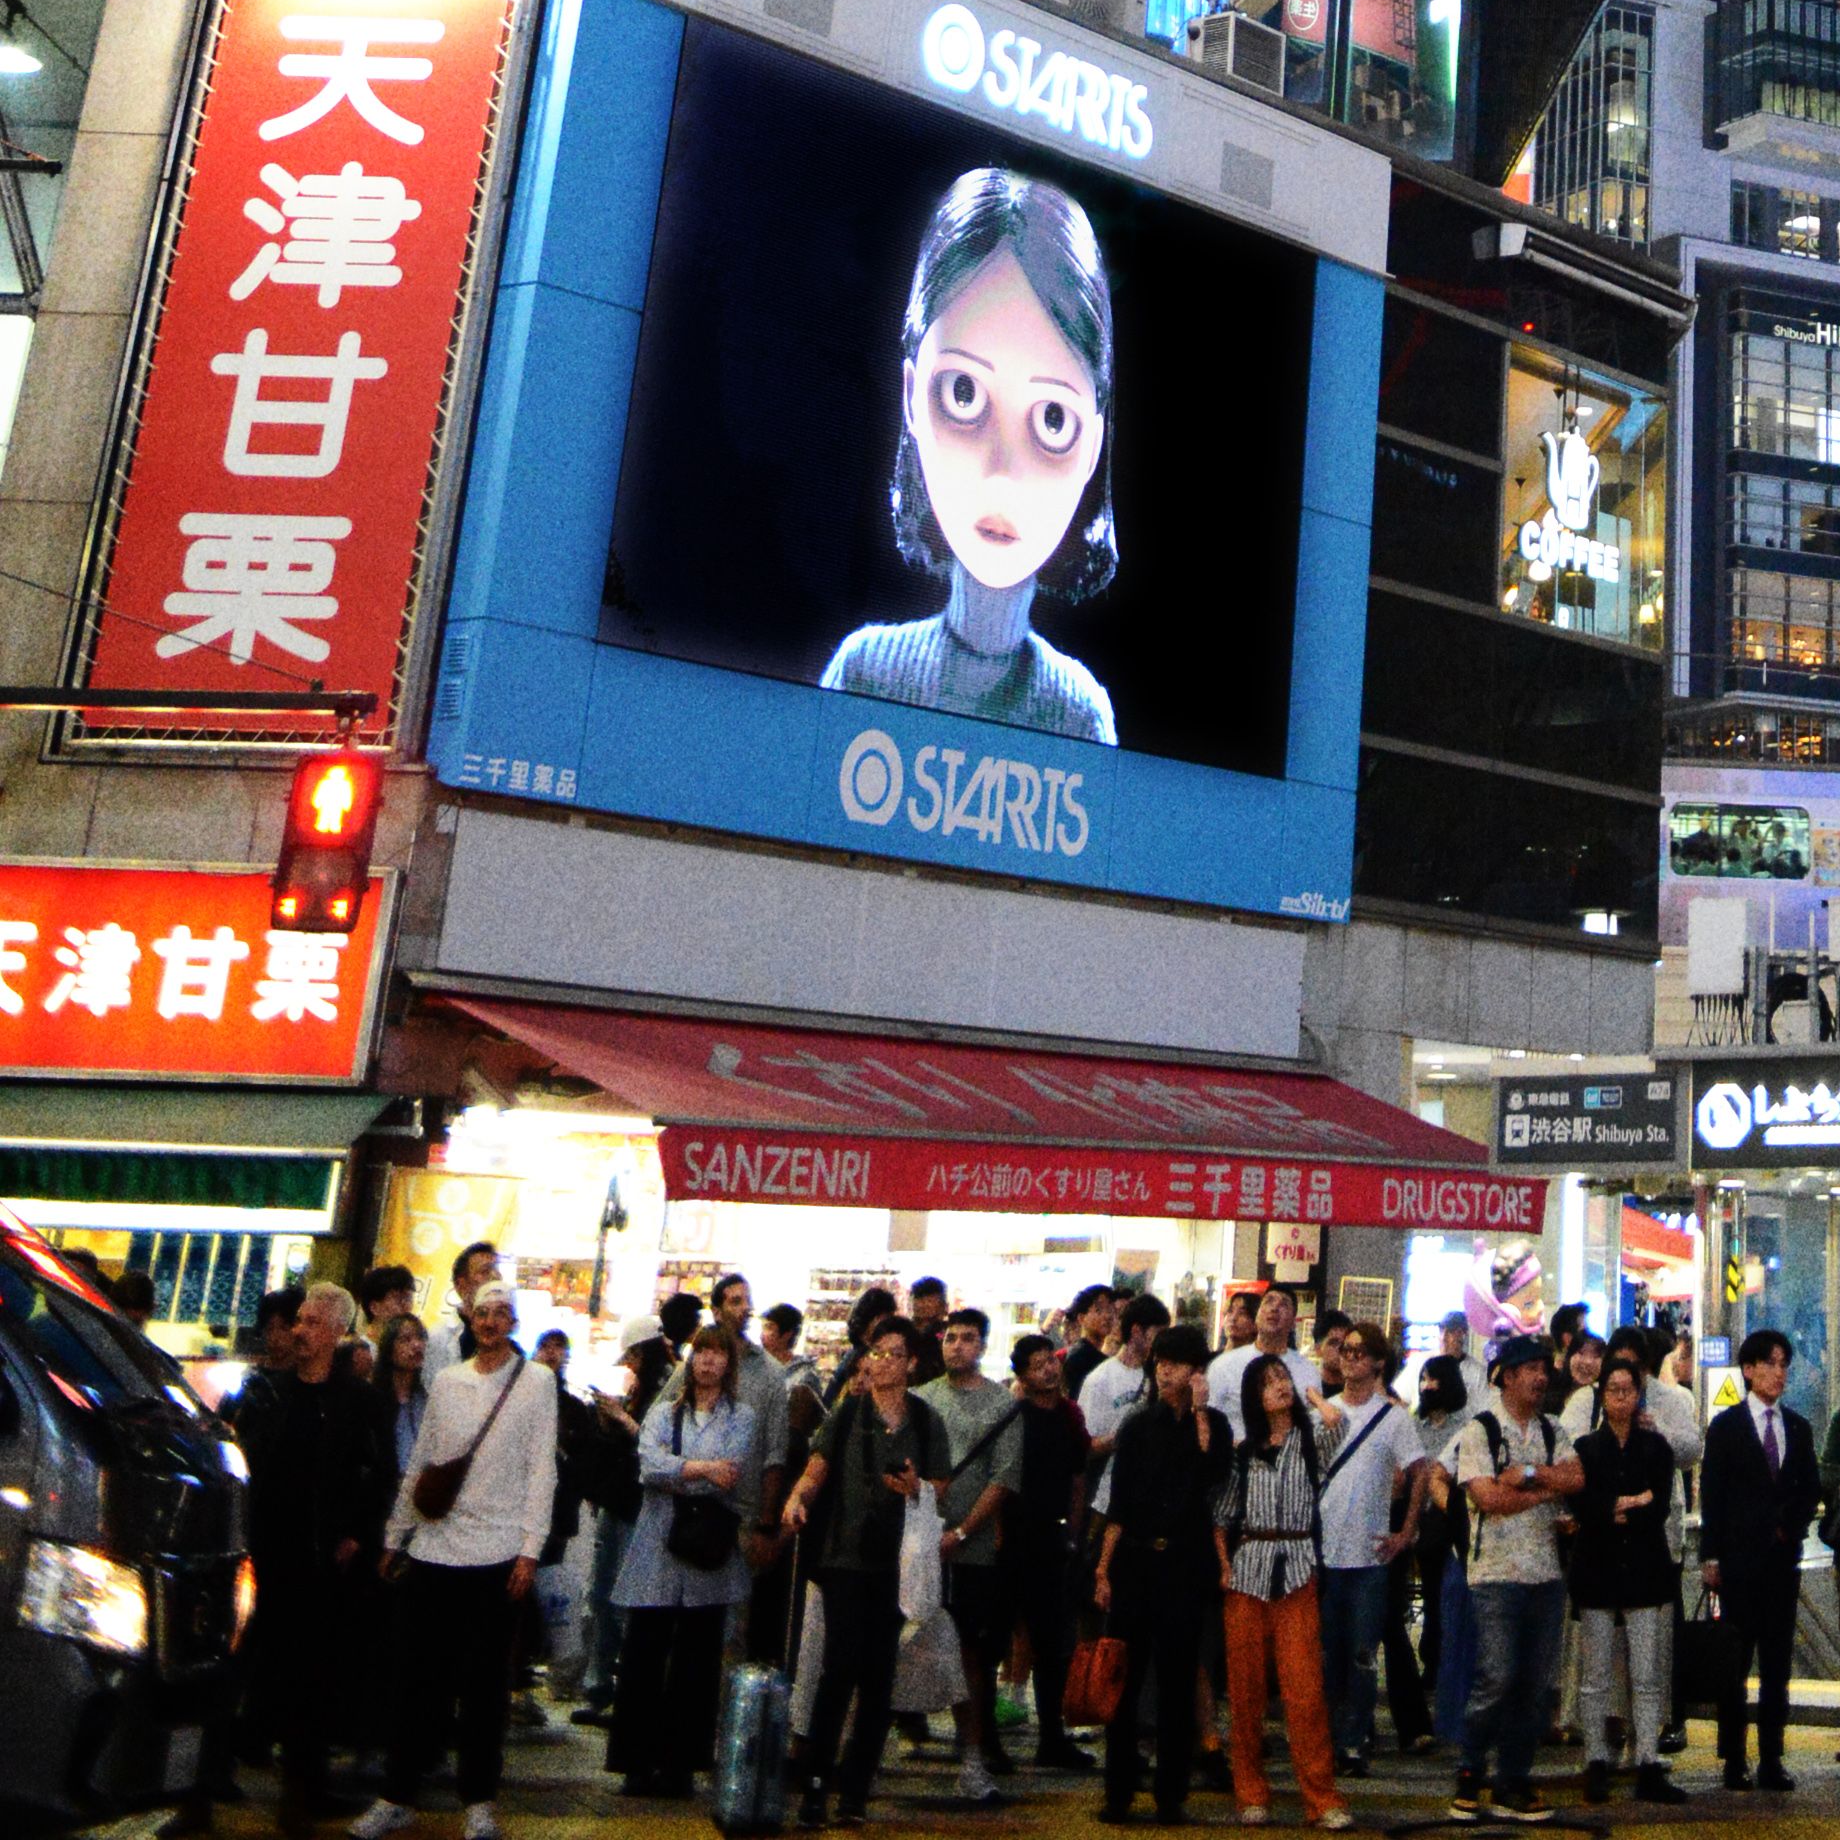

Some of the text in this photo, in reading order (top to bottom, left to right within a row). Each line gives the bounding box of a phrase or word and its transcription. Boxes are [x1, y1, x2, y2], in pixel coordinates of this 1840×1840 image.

[155, 14, 446, 666] 天津甘栗
[1773, 323, 1816, 344] Shibuya
[1519, 520, 1620, 584] COFFEE
[458, 753, 577, 800] 三千里薬品
[907, 745, 1090, 857] STARTS
[1531, 1116, 1592, 1144] 渋谷駅
[1595, 1124, 1669, 1146] Shibuya Sta.
[684, 1141, 870, 1199] SANZENRI
[1165, 1161, 1334, 1223] 三千里薬品
[1382, 1177, 1532, 1228] DRUGSTORE
